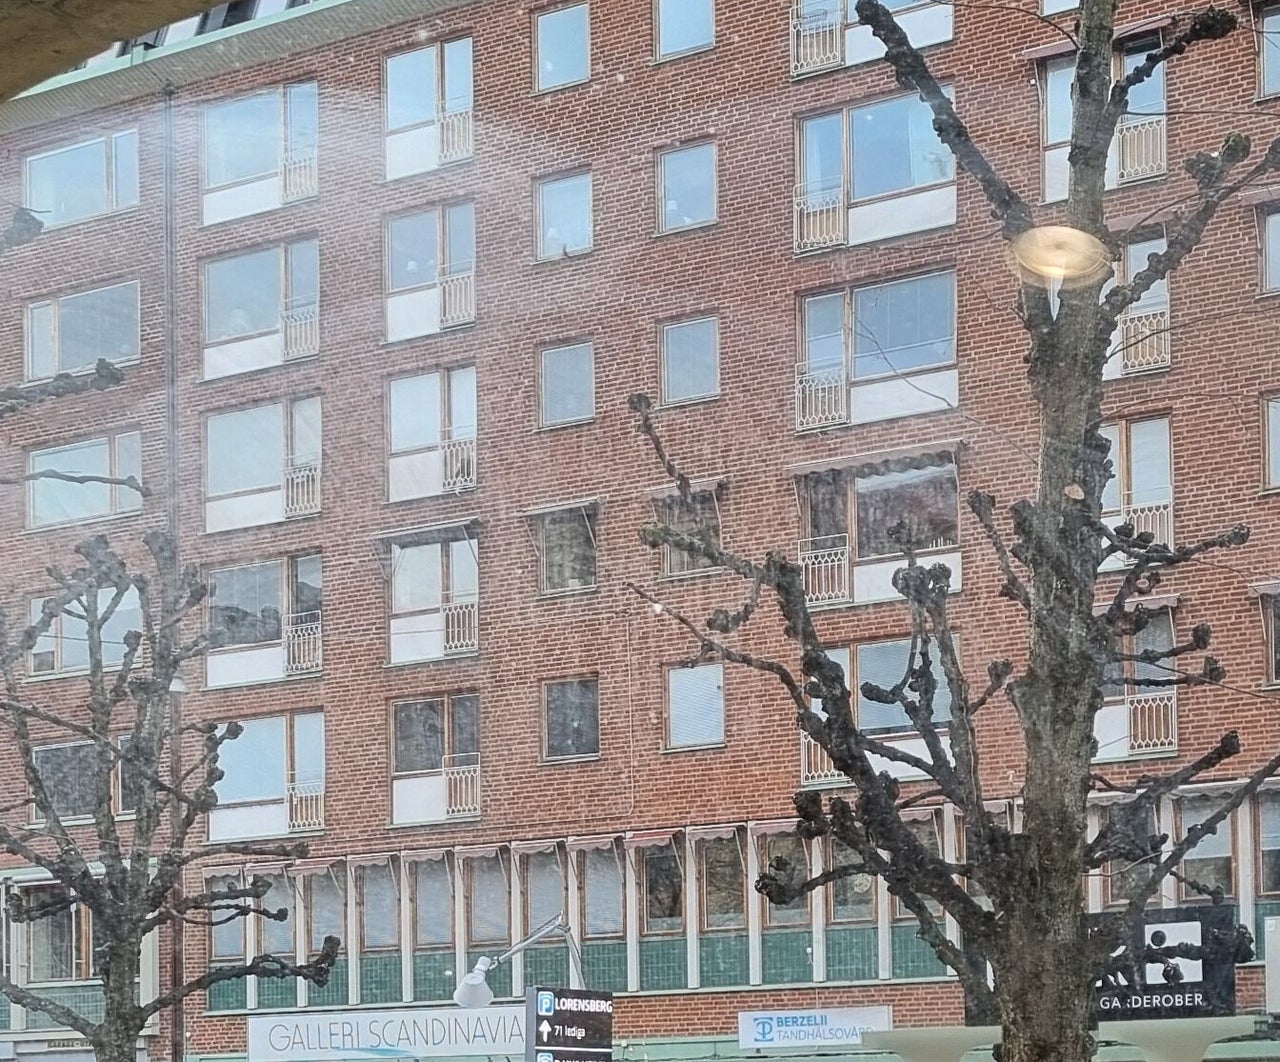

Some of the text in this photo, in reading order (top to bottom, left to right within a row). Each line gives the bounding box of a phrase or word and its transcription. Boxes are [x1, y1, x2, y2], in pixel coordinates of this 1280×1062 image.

[554, 997, 613, 1013] LORENSBERG
[776, 1015, 827, 1028] BERZELII
[269, 1014, 524, 1050] GALLERI SCANDINAVIA
[554, 1026, 586, 1039] 71 lediga
